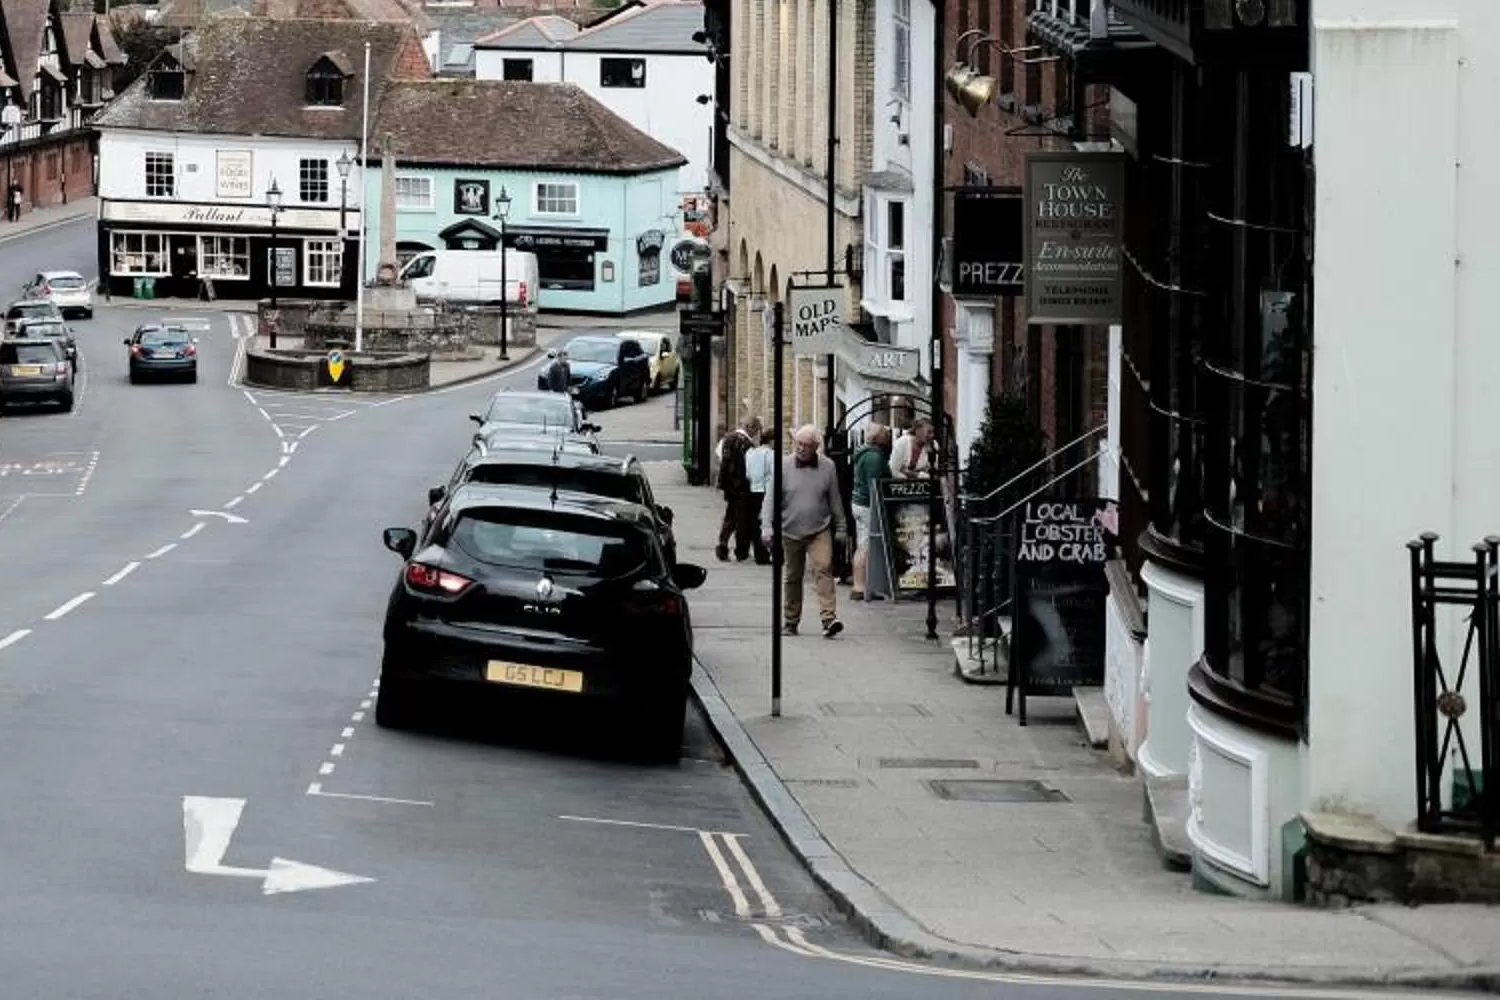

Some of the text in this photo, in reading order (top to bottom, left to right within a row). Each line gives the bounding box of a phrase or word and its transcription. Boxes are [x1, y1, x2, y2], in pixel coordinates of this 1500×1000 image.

[1043, 183, 1109, 201] TOWN
[1038, 201, 1115, 218] HOUSE
[959, 261, 1025, 286] PREZZ
[799, 299, 836, 321] OLD
[795, 315, 842, 338] MAPS
[868, 351, 908, 369] ART
[1025, 501, 1085, 523] LOCAL
[1021, 522, 1106, 544] LOBSTER
[1017, 543, 1107, 565] AND CRAB
